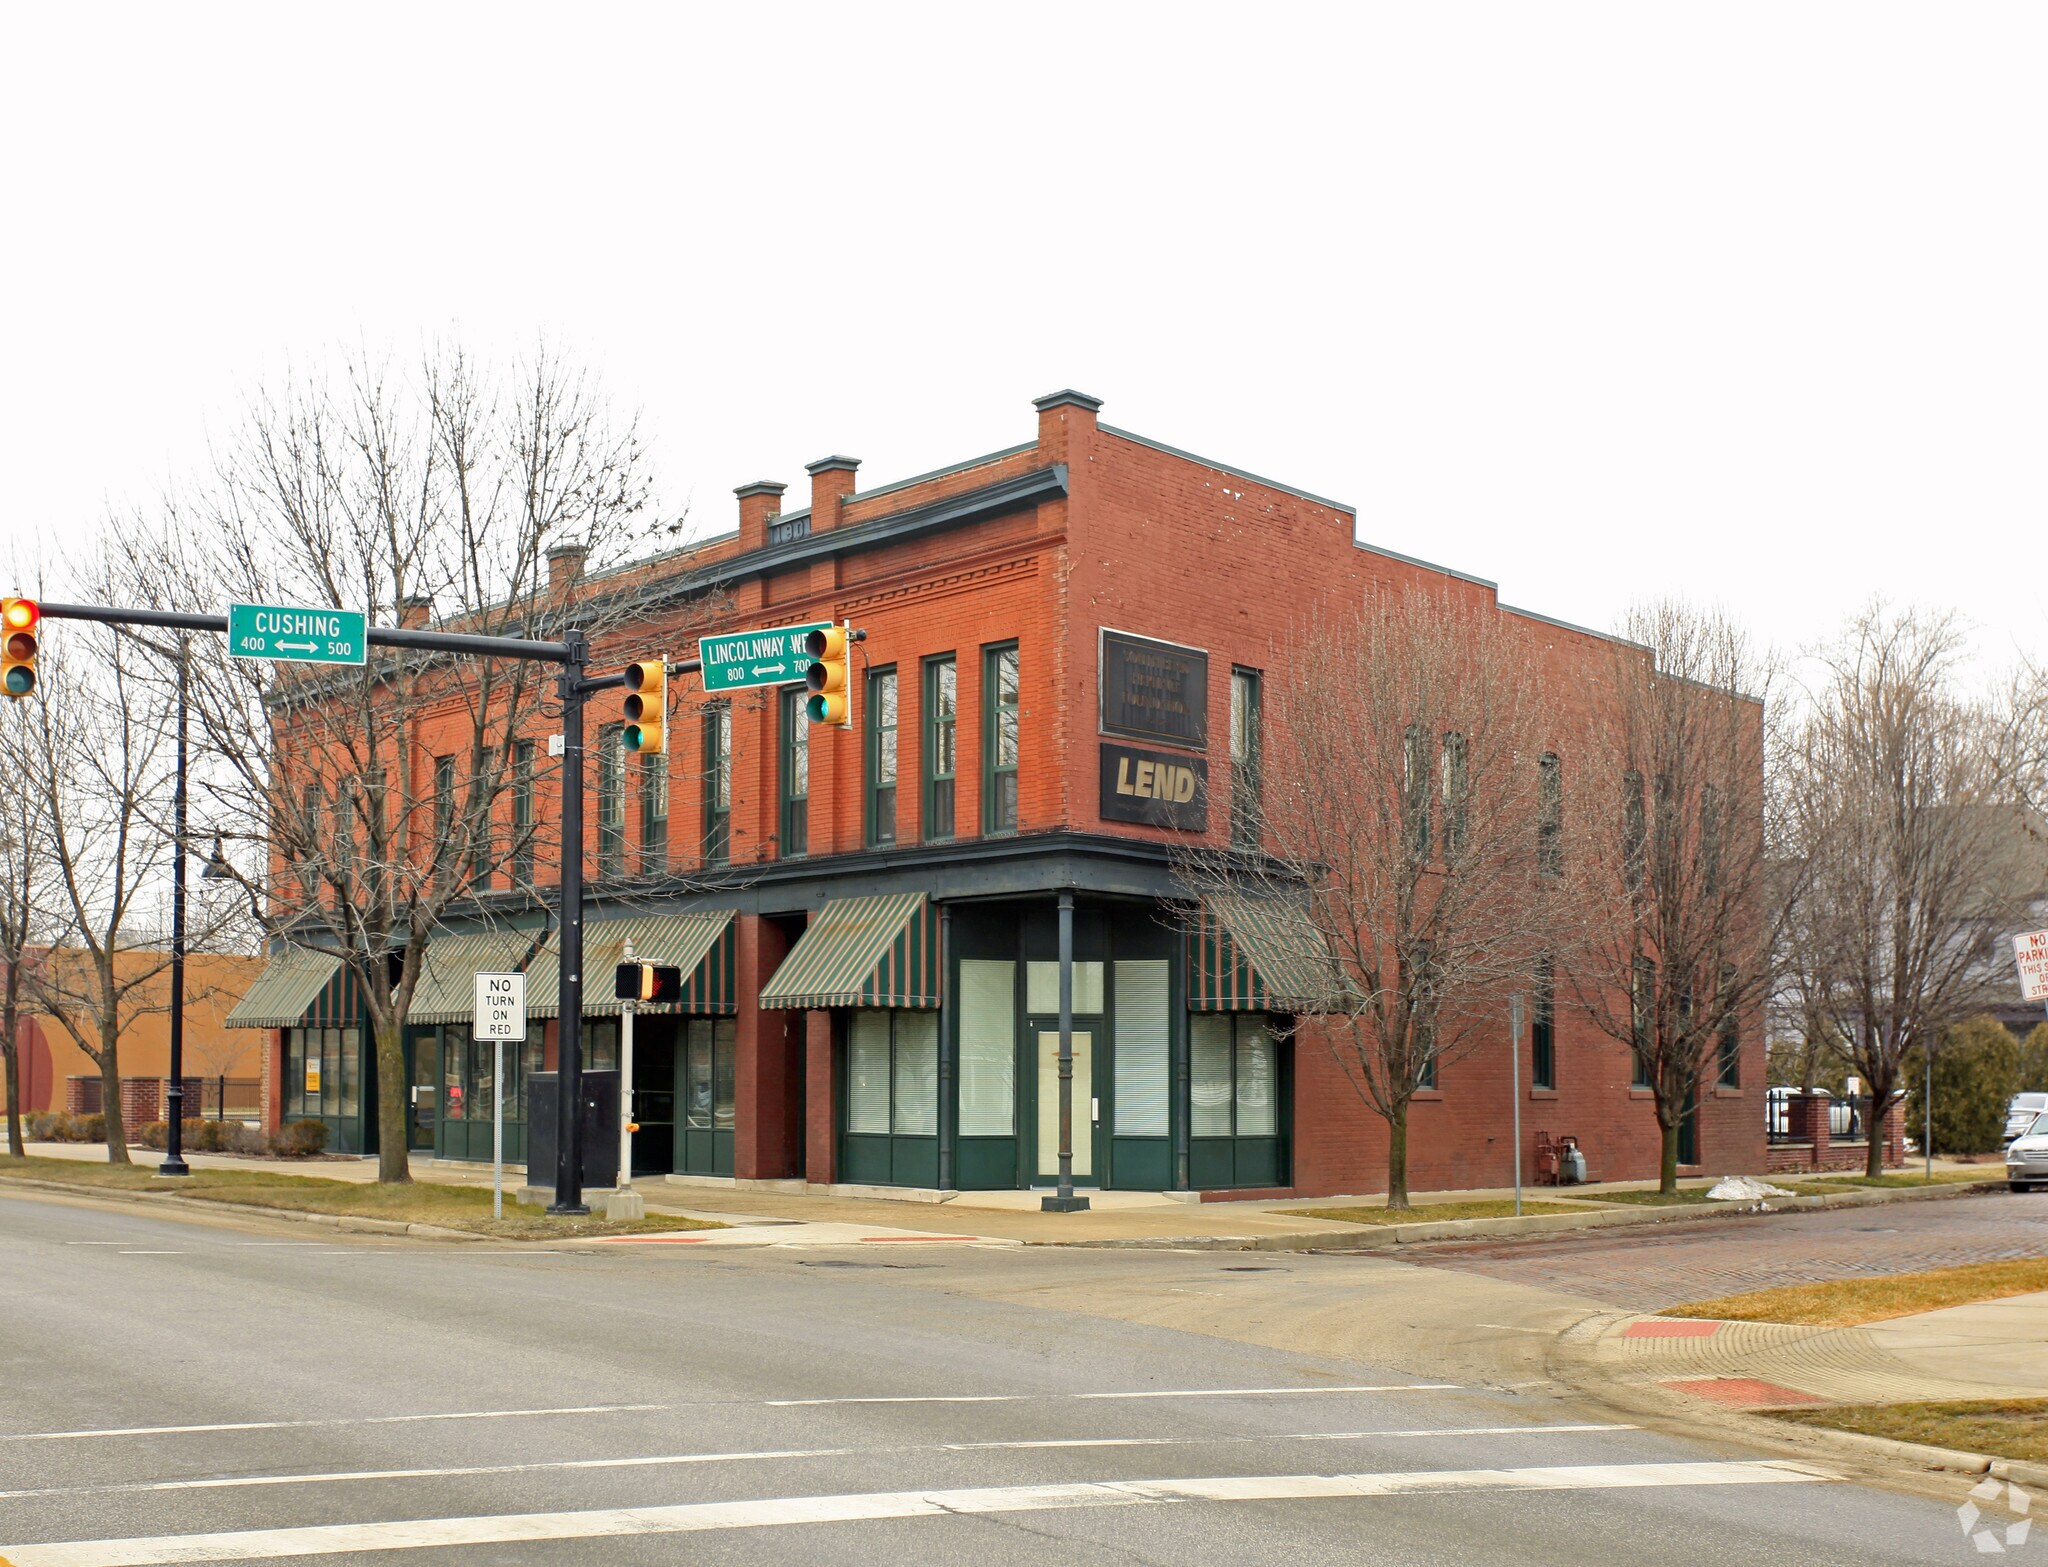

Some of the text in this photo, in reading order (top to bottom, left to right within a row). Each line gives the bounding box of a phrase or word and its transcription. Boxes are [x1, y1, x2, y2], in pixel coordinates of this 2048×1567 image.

[255, 612, 340, 637] CUSHING
[241, 637, 351, 655] 400 500
[708, 636, 784, 665] LINCOLNWAY
[727, 659, 811, 681] 800 700
[1116, 756, 1195, 803] LEND
[2029, 934, 2046, 947] NO
[2023, 964, 2041, 975] THIS
[490, 979, 511, 992] NO
[486, 996, 515, 1006] TURN
[493, 1010, 507, 1020] ON
[490, 1024, 511, 1035] RED
